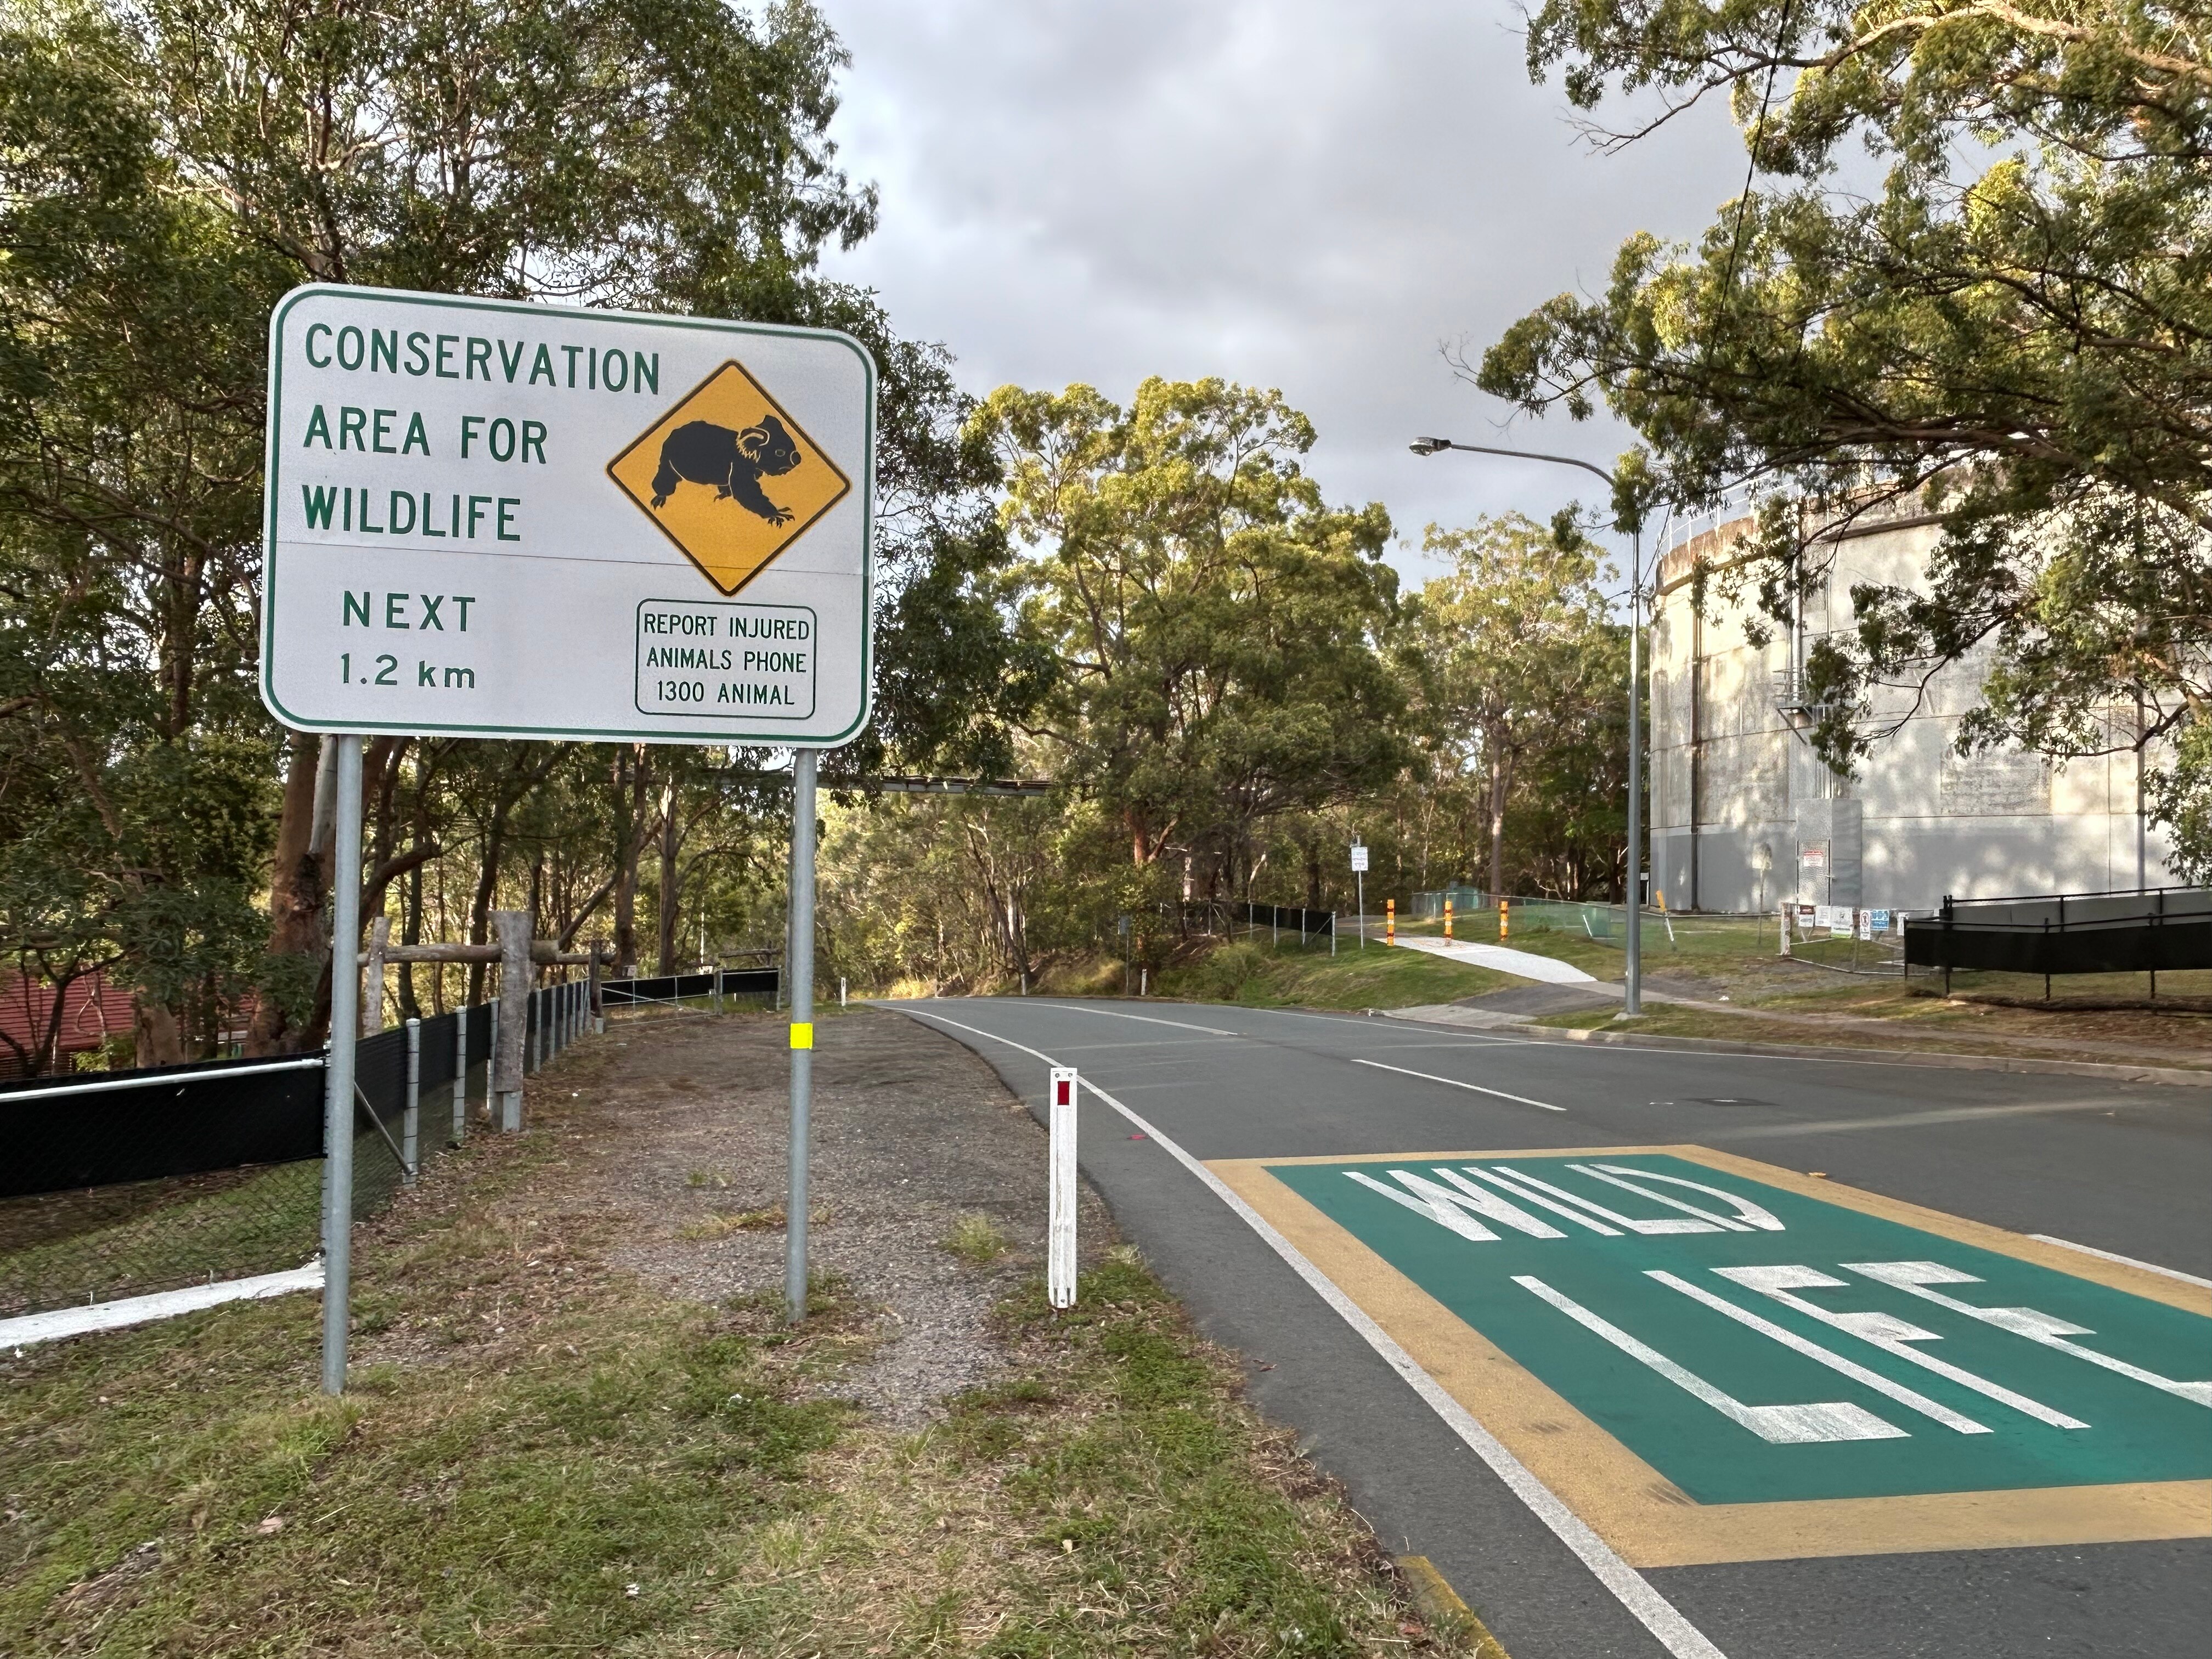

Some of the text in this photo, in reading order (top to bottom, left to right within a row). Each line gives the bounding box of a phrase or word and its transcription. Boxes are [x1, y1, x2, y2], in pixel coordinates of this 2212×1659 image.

[306, 324, 659, 394] CONSERVATION
[303, 405, 547, 464] AREA FOR
[302, 485, 520, 541] WILDLIFE
[343, 591, 475, 631] NEXT
[645, 614, 809, 640] REPORT INJURED
[341, 653, 475, 689] 1.2 km
[647, 647, 806, 673] ANIMALS PHONE
[657, 680, 795, 705] 1300 ANIMAL
[1342, 1164, 1786, 1240] WILD
[1510, 1261, 2212, 1444] LIFE
